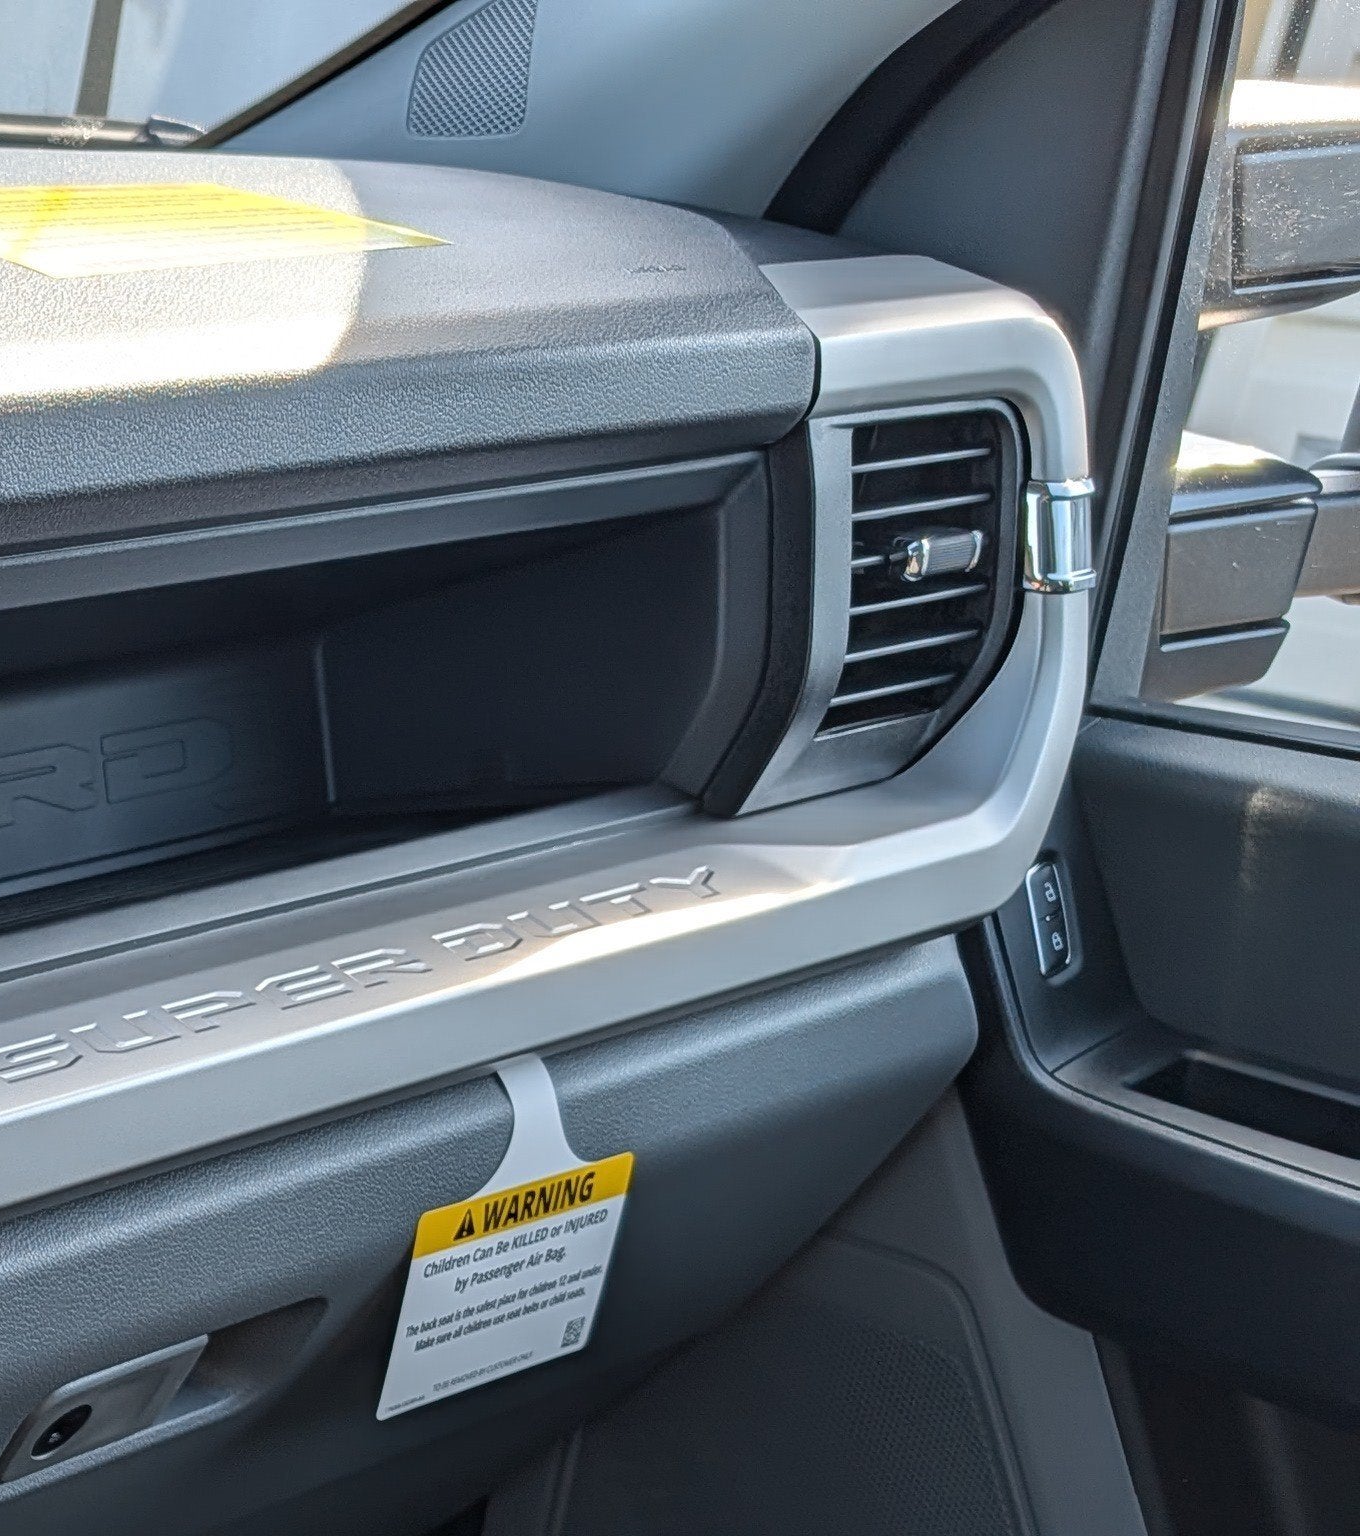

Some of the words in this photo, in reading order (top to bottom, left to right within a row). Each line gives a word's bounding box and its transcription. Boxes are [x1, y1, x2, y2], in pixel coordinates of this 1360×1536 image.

[432, 864, 722, 961] DUTY
[483, 1172, 596, 1233] WARNING
[424, 1254, 470, 1278] Children
[473, 1247, 493, 1262] Can
[495, 1241, 509, 1255] Be
[511, 1227, 548, 1250] KILLED
[550, 1225, 563, 1238] or
[564, 1209, 608, 1234] INJURED
[454, 1278, 469, 1293] by
[470, 1259, 525, 1286] Passenger
[526, 1252, 543, 1268] Air
[545, 1247, 565, 1262] Bag.
[406, 1325, 419, 1338] The
[420, 1318, 437, 1333] back
